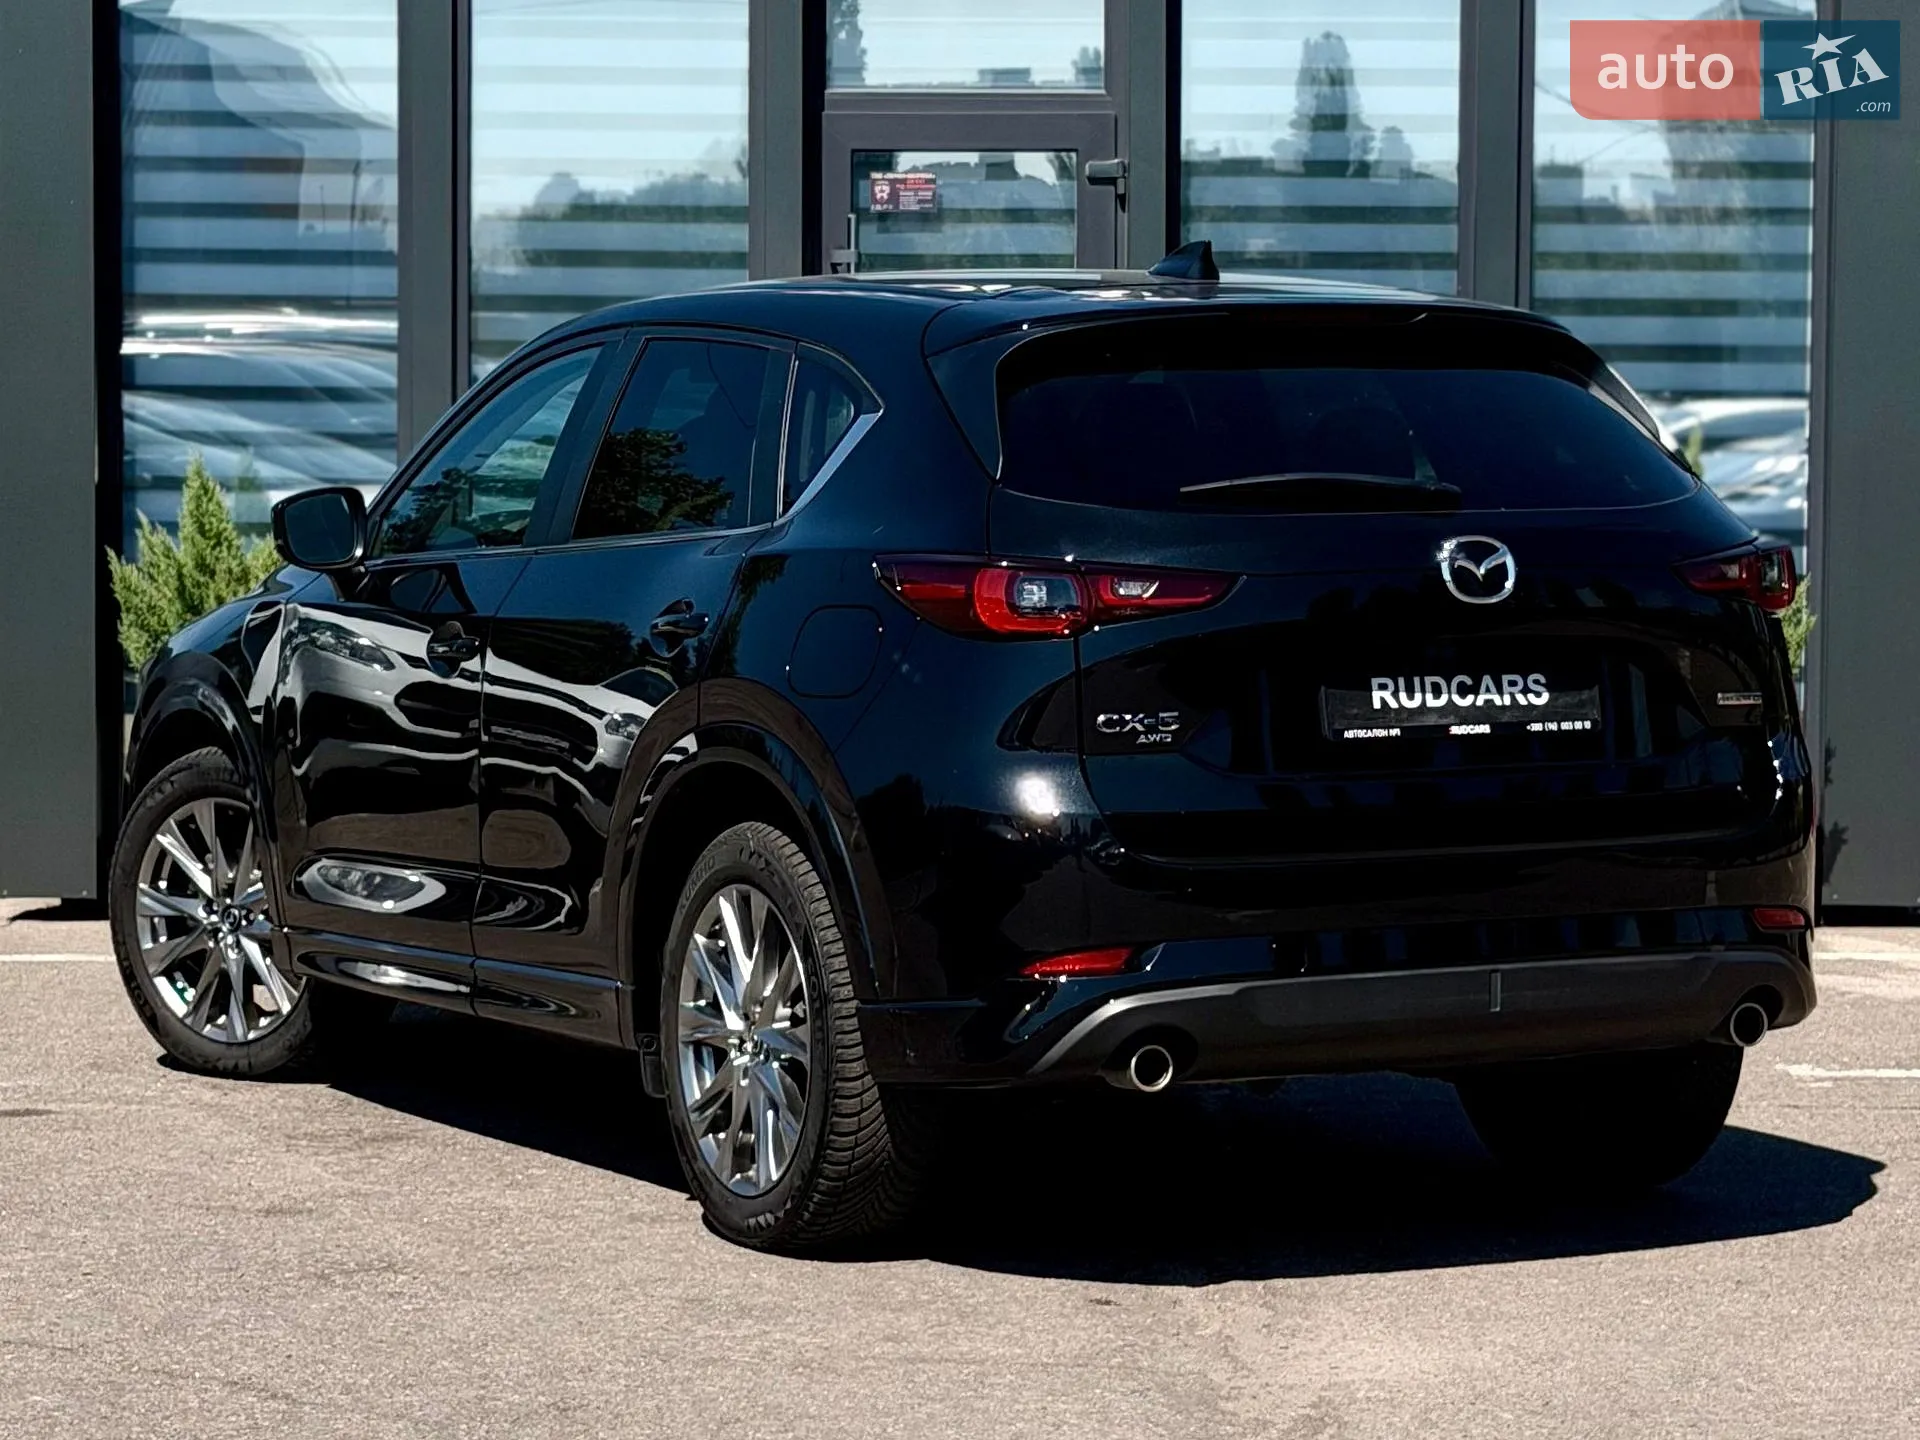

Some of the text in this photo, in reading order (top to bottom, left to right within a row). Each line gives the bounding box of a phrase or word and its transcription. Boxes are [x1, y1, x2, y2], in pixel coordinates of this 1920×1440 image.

[1370, 673, 1550, 710] RUDCARS
[1096, 711, 1180, 733] CX-5
[1135, 733, 1172, 744] AWD
